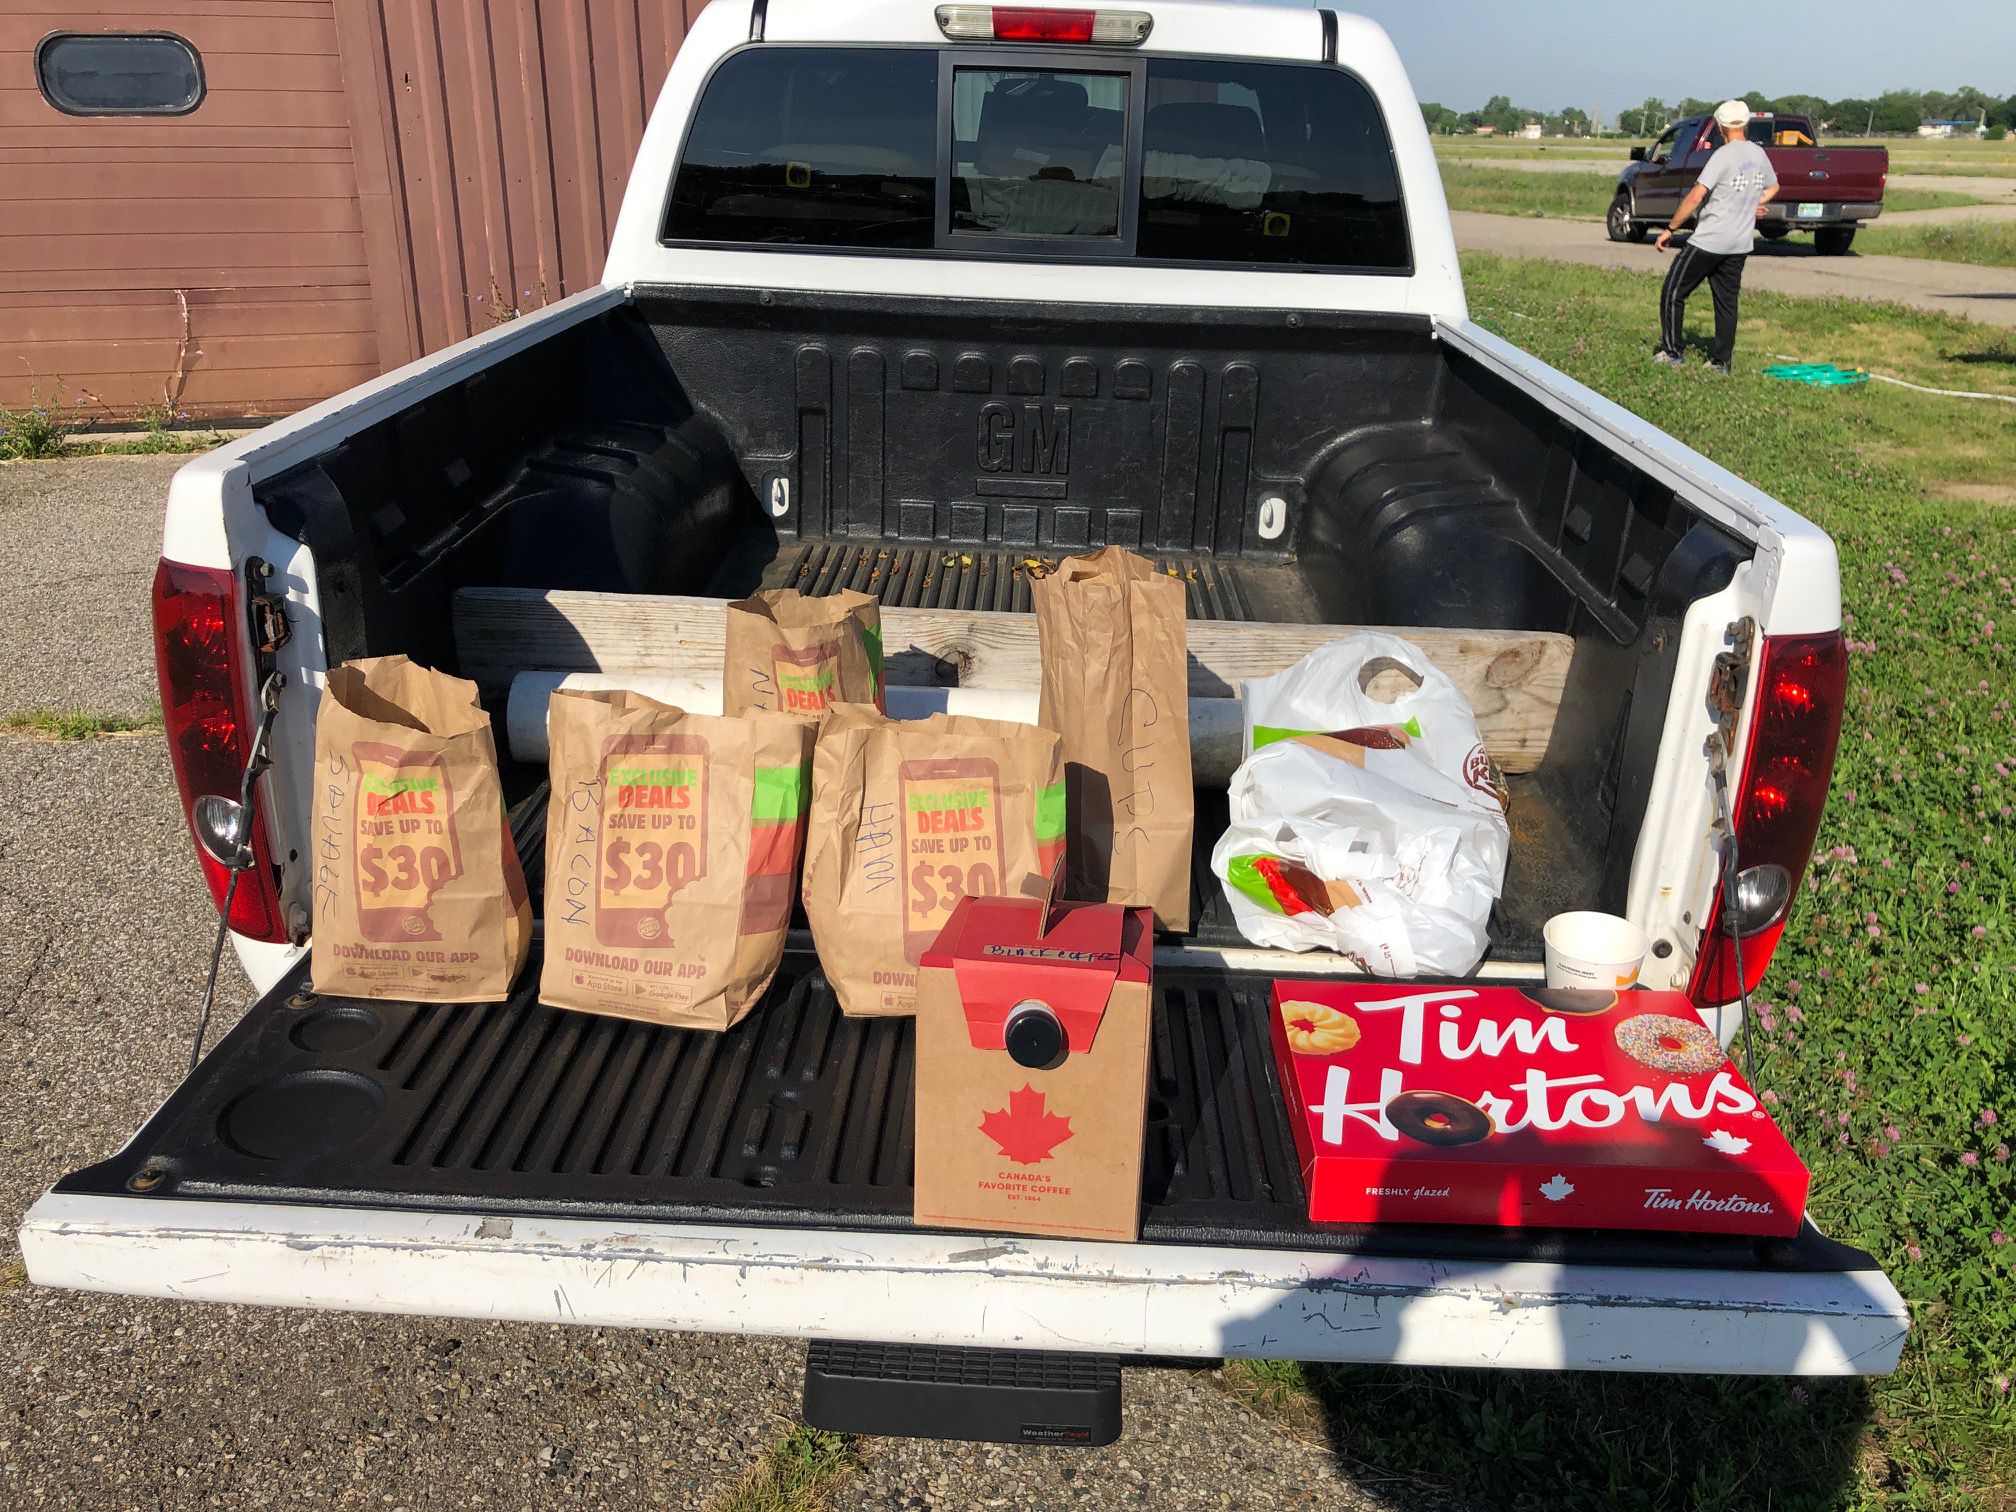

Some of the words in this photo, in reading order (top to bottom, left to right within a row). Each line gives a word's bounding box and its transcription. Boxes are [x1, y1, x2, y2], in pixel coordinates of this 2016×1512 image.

[977, 401, 1072, 475] GM
[609, 768, 698, 786] EXCLUSIVE
[1113, 688, 1158, 856] CUPS
[366, 790, 435, 816] DEALS
[618, 785, 691, 809] DEALS
[360, 819, 395, 836] SAVE
[399, 819, 421, 835] UP
[425, 819, 443, 835] TO
[608, 814, 646, 830] SAVE
[651, 814, 673, 829] UP
[678, 815, 696, 830] TO
[917, 807, 985, 833] DEALS
[561, 776, 604, 925] BACON
[855, 802, 896, 894] HAM
[912, 838, 944, 853] SAVE
[949, 837, 969, 853] UP
[974, 835, 992, 851] TO
[360, 844, 452, 897] $30
[604, 836, 696, 896] $30
[911, 860, 996, 918] $30
[333, 943, 411, 962] DOWNLOAD
[416, 950, 446, 963] OUR
[450, 952, 480, 963] APP
[565, 947, 639, 972] DOWNLOAD
[643, 960, 674, 976] OUR
[677, 963, 707, 979] APP
[587, 980, 602, 990] App
[603, 983, 623, 992] Store
[873, 971, 917, 987] DOWN
[649, 989, 673, 999] Google
[674, 992, 690, 1002] Play
[1354, 989, 1579, 1065] Tim
[1308, 1064, 1758, 1145] Hrtons
[978, 1181, 1028, 1192] FAVORITE
[1031, 1185, 1071, 1195] COFFEE
[998, 1171, 1052, 1182] CANADA'S
[1365, 1187, 1411, 1196] FRESHLY
[1412, 1185, 1451, 1200] glazed
[1643, 1188, 1683, 1210] Tim
[1684, 1189, 1771, 1213] Hortons
